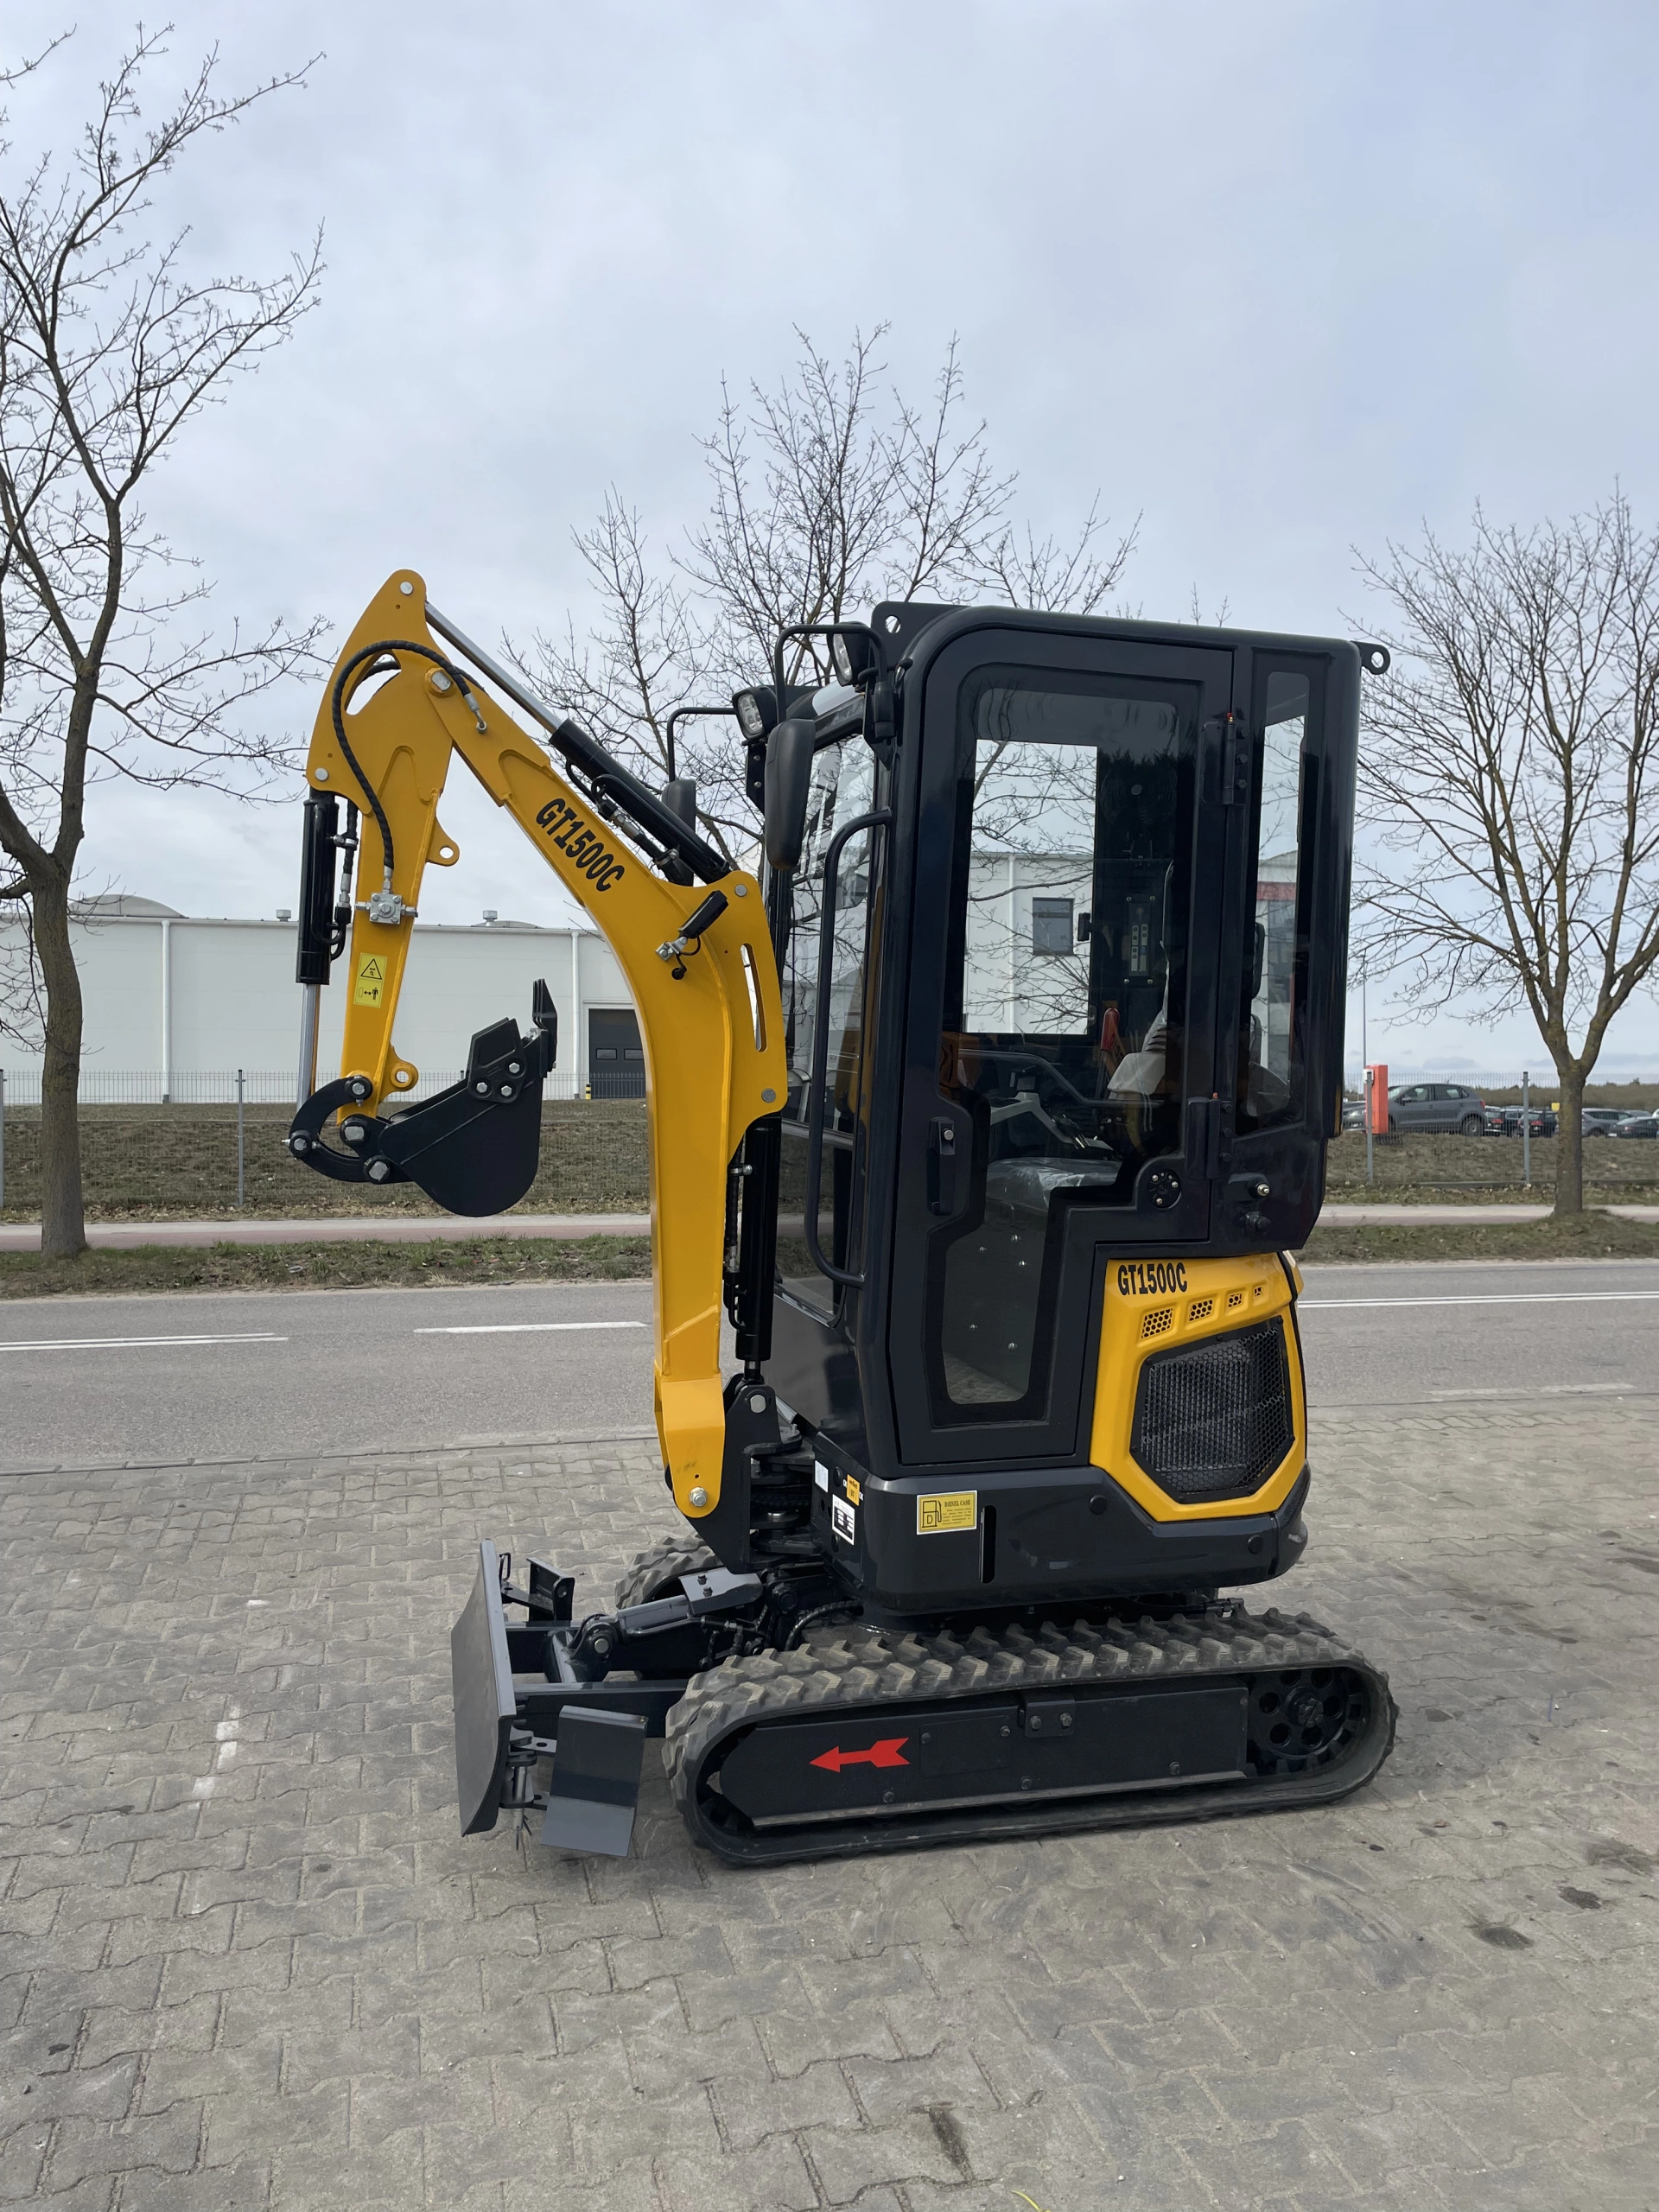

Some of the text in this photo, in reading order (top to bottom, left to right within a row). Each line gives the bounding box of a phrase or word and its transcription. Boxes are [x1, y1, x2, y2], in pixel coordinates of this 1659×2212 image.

[536, 798, 625, 892] GT1500C
[1117, 1262, 1187, 1295] GT1500C
[927, 1515, 933, 1524] D
